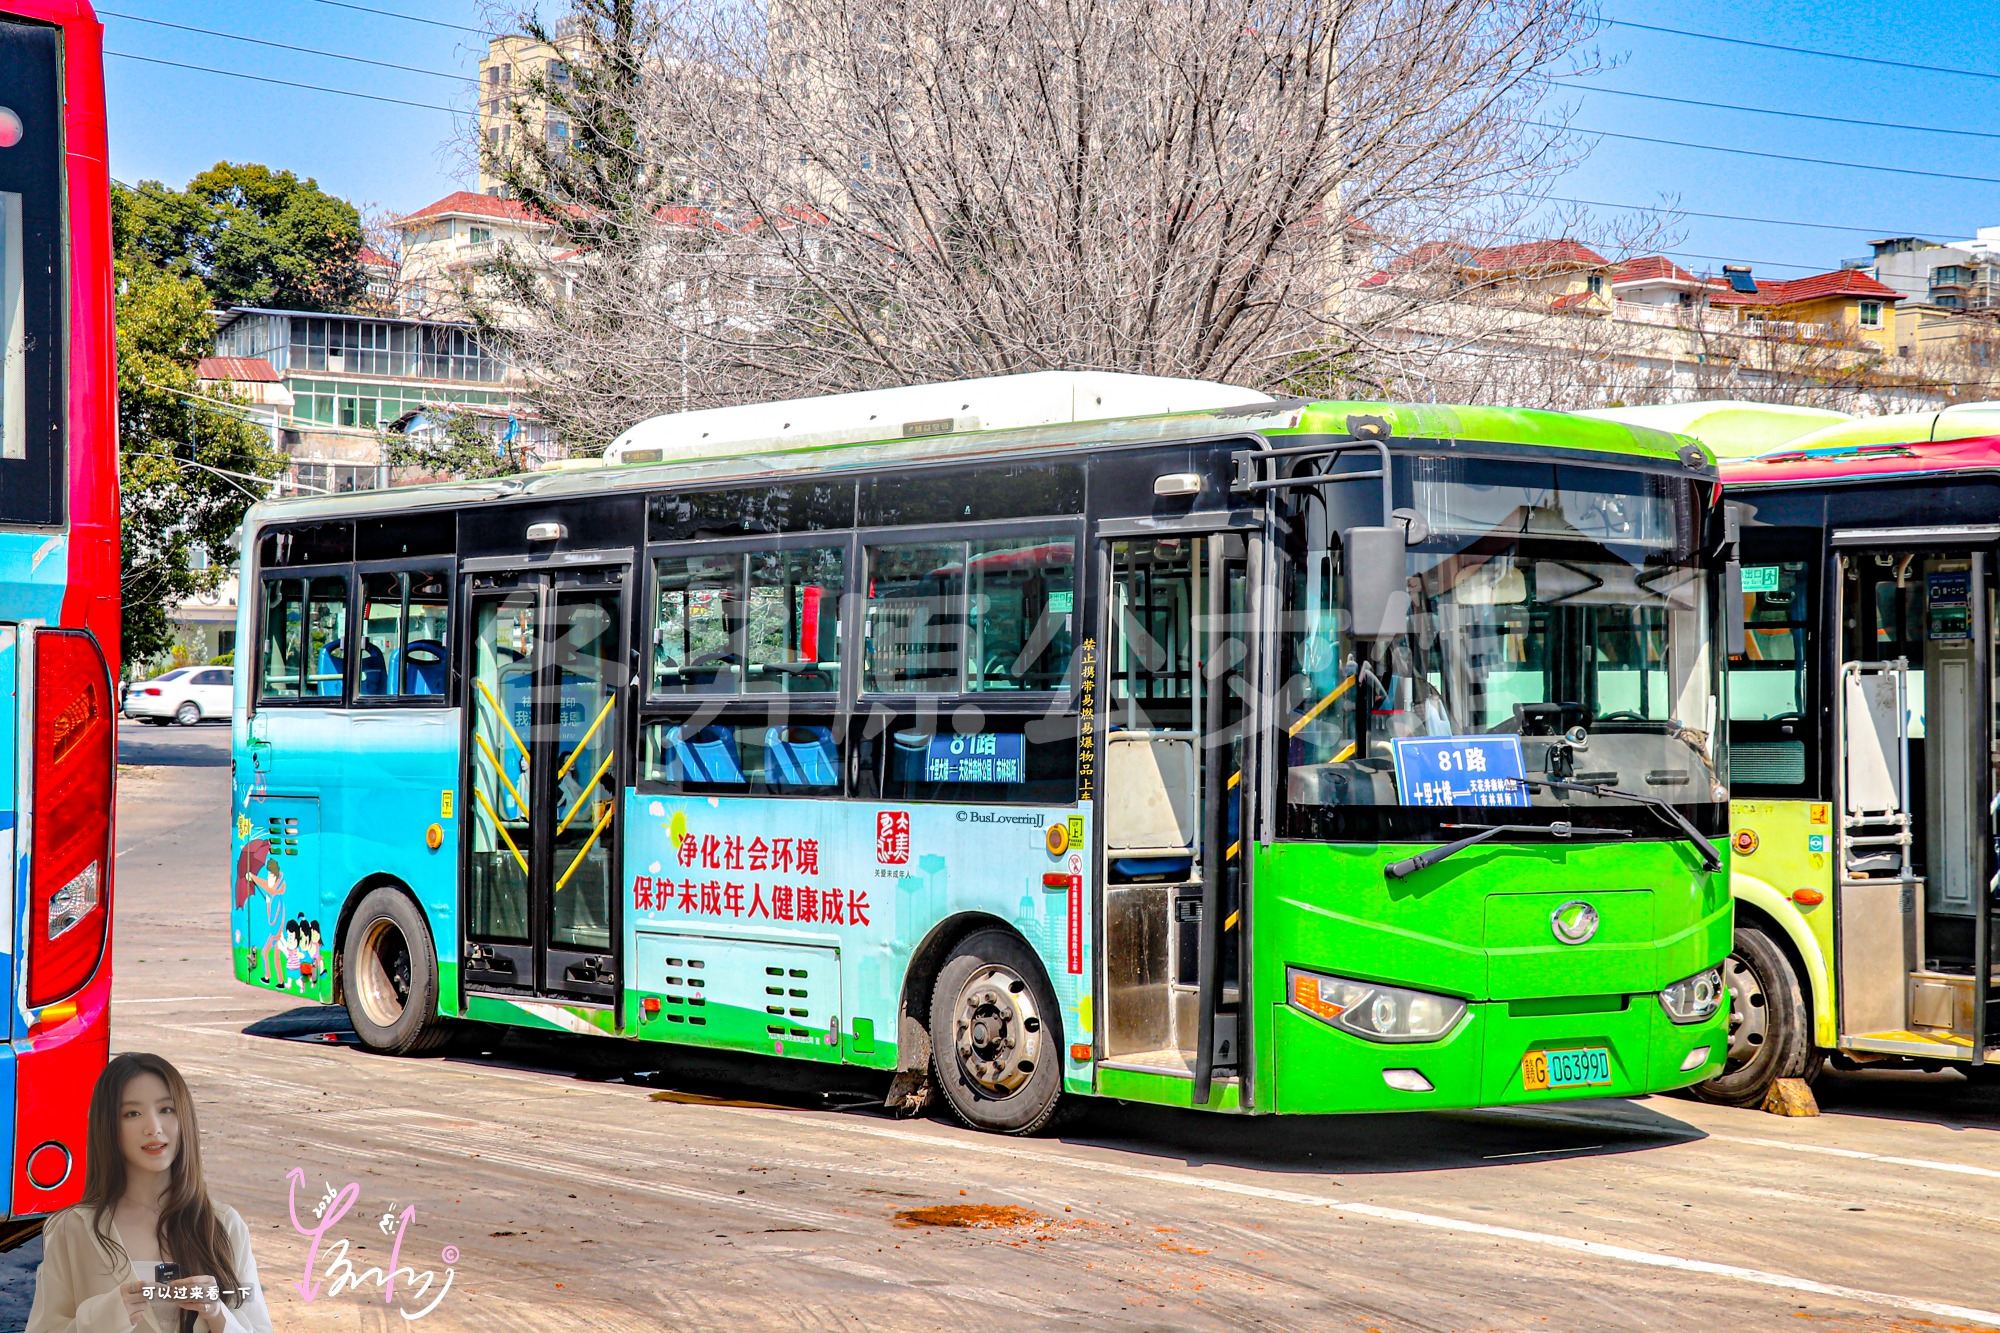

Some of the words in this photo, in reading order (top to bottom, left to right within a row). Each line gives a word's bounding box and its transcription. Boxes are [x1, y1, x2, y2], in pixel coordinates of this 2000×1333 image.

[1078, 638, 1096, 800] 禁止携带易燃易爆物品上车
[950, 733, 996, 756] 81路
[1437, 747, 1487, 772] 81路
[676, 834, 819, 876] 净化社会环境
[633, 875, 870, 927] 保护未成年人健康成长
